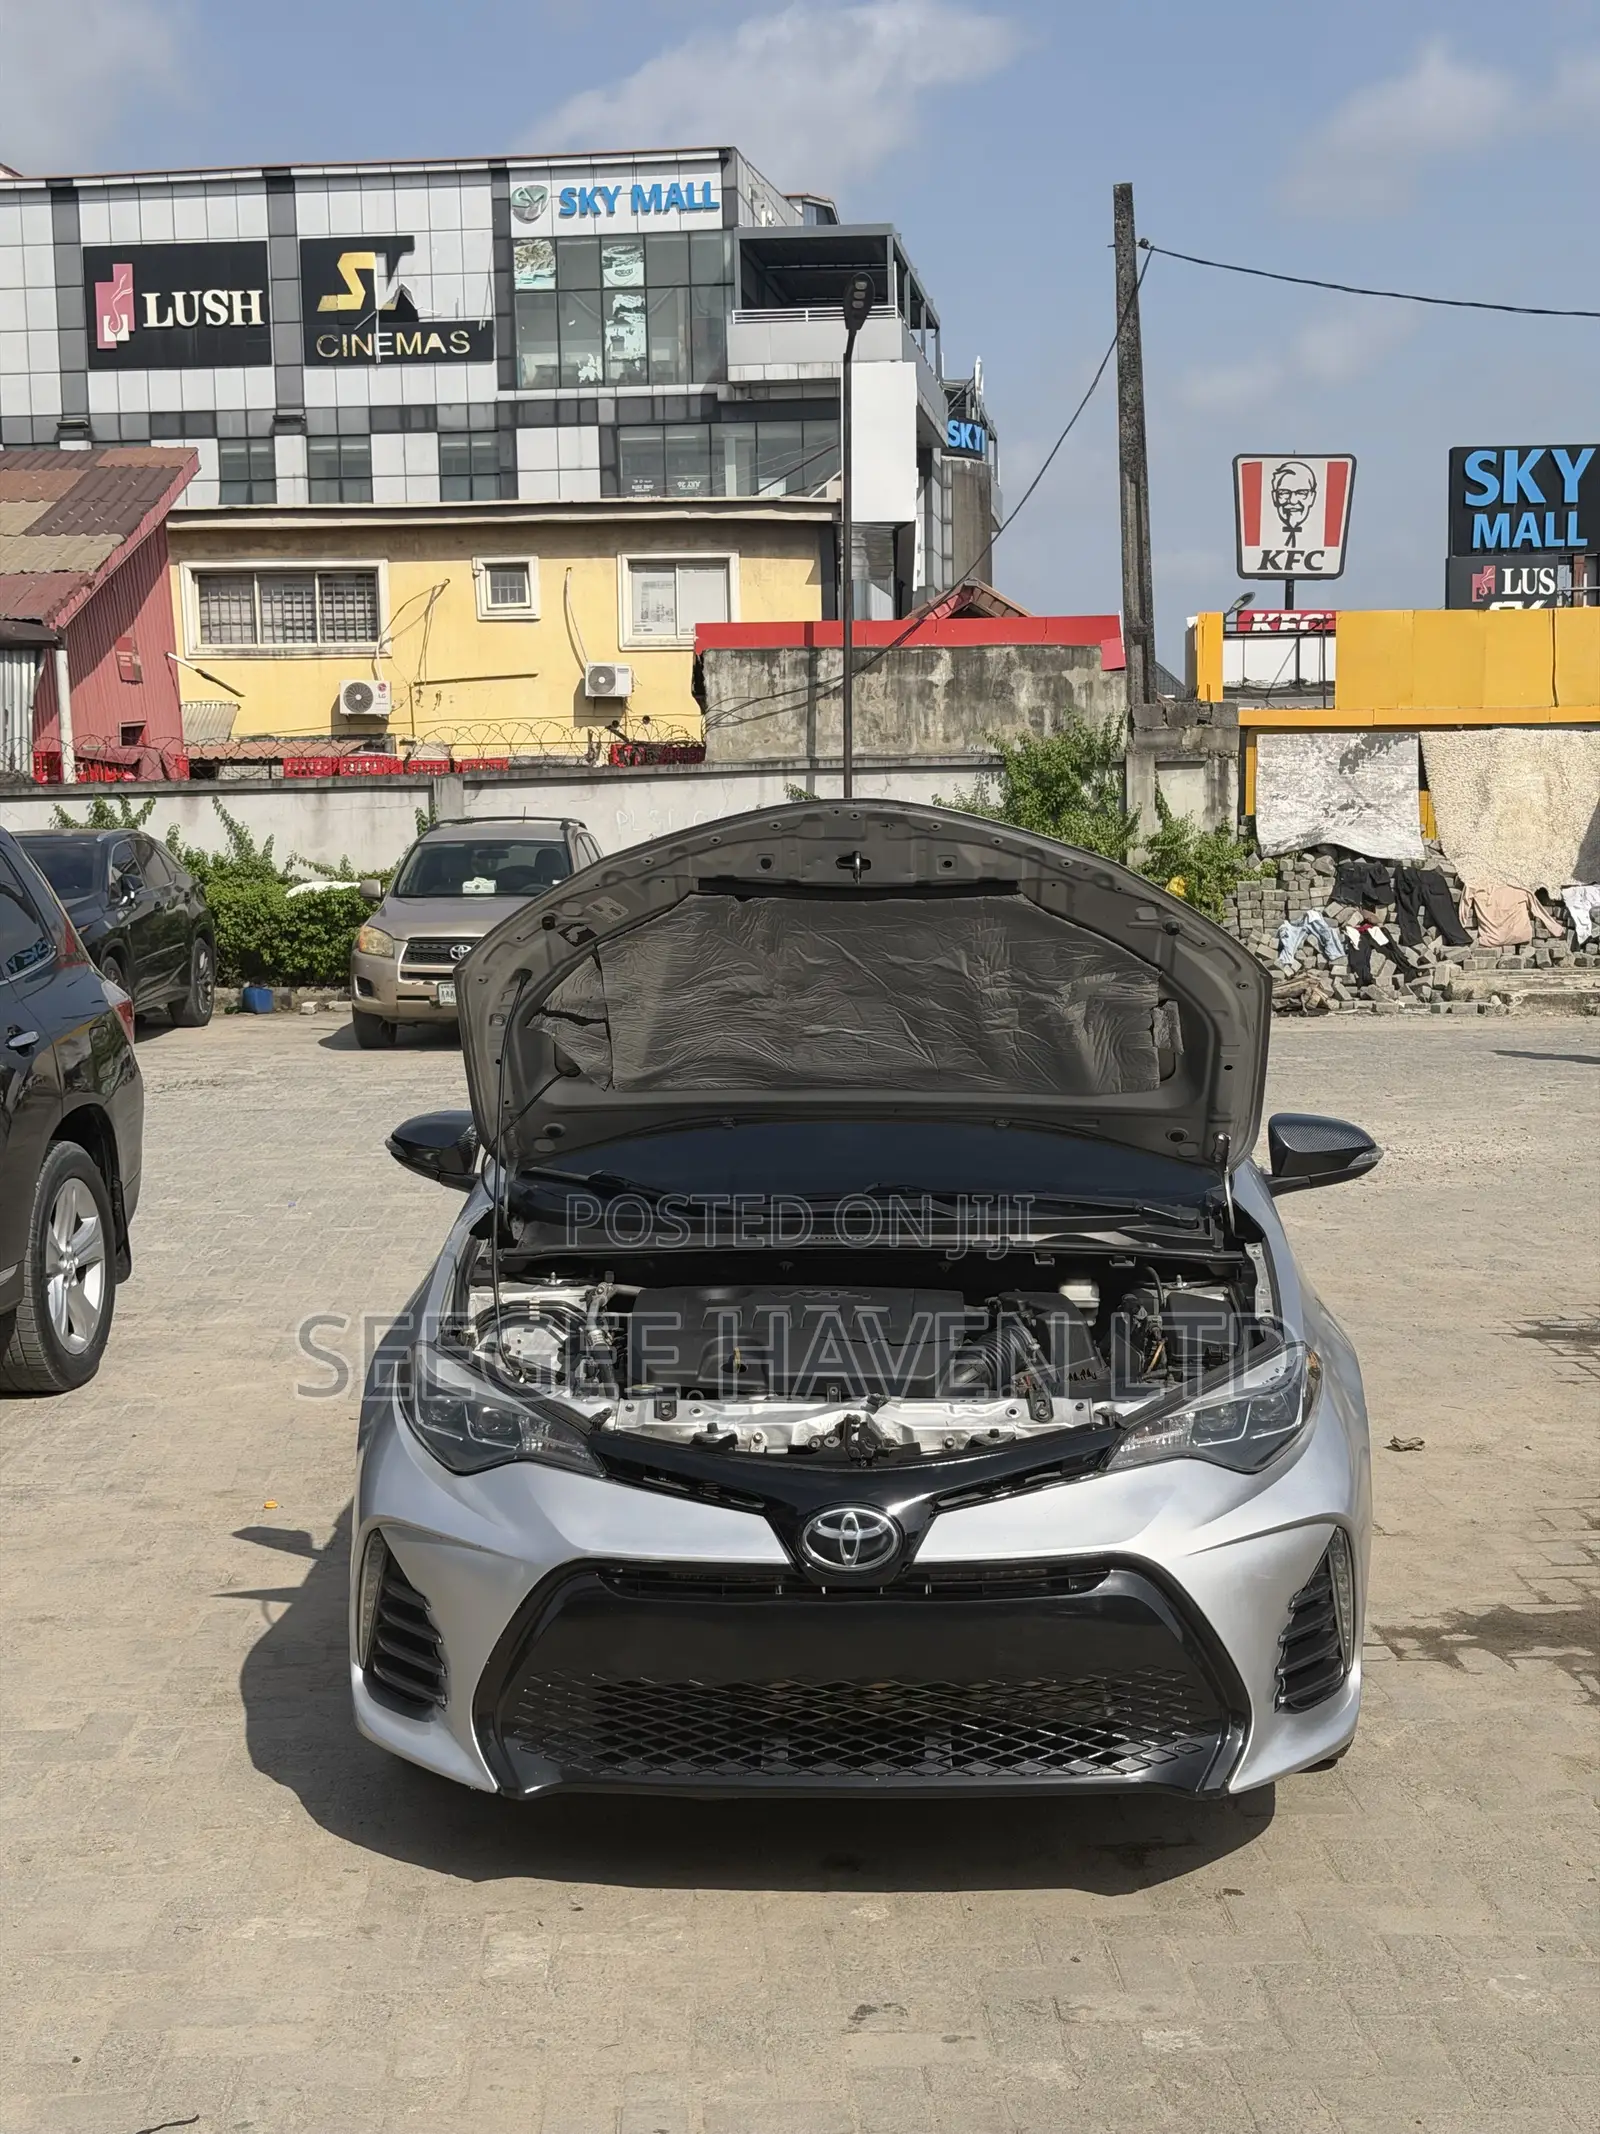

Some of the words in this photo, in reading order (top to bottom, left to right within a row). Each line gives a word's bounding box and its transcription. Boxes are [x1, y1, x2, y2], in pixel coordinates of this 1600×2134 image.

[559, 185, 622, 217] SKY
[630, 181, 720, 214] MALL
[141, 289, 265, 328] LUSH
[316, 330, 471, 358] CINEMAS
[947, 419, 983, 452] SKY
[1464, 448, 1596, 507] SKY
[1472, 511, 1588, 549] MALL
[1257, 549, 1325, 571] KFC
